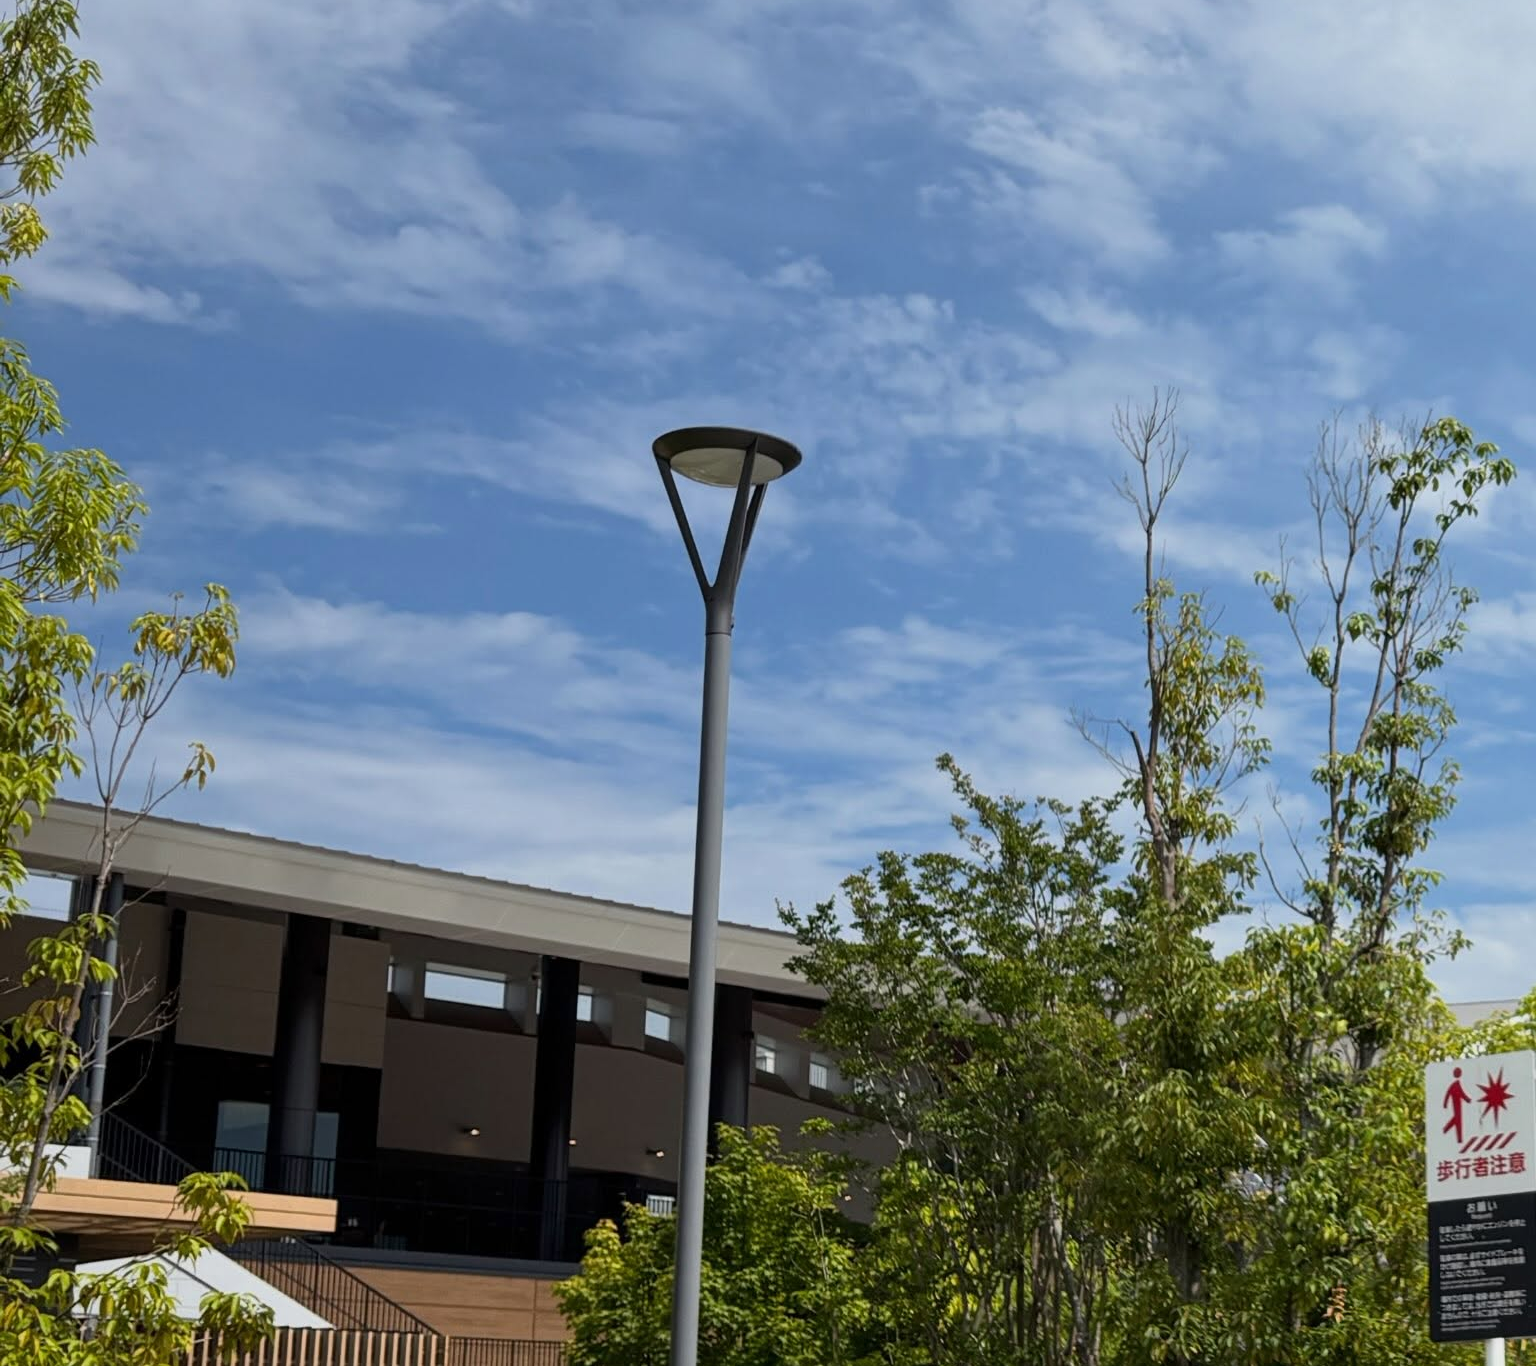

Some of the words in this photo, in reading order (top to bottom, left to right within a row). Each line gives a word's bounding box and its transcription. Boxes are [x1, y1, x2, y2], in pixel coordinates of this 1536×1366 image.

[1436, 1152, 1526, 1182] 歩行者注意
